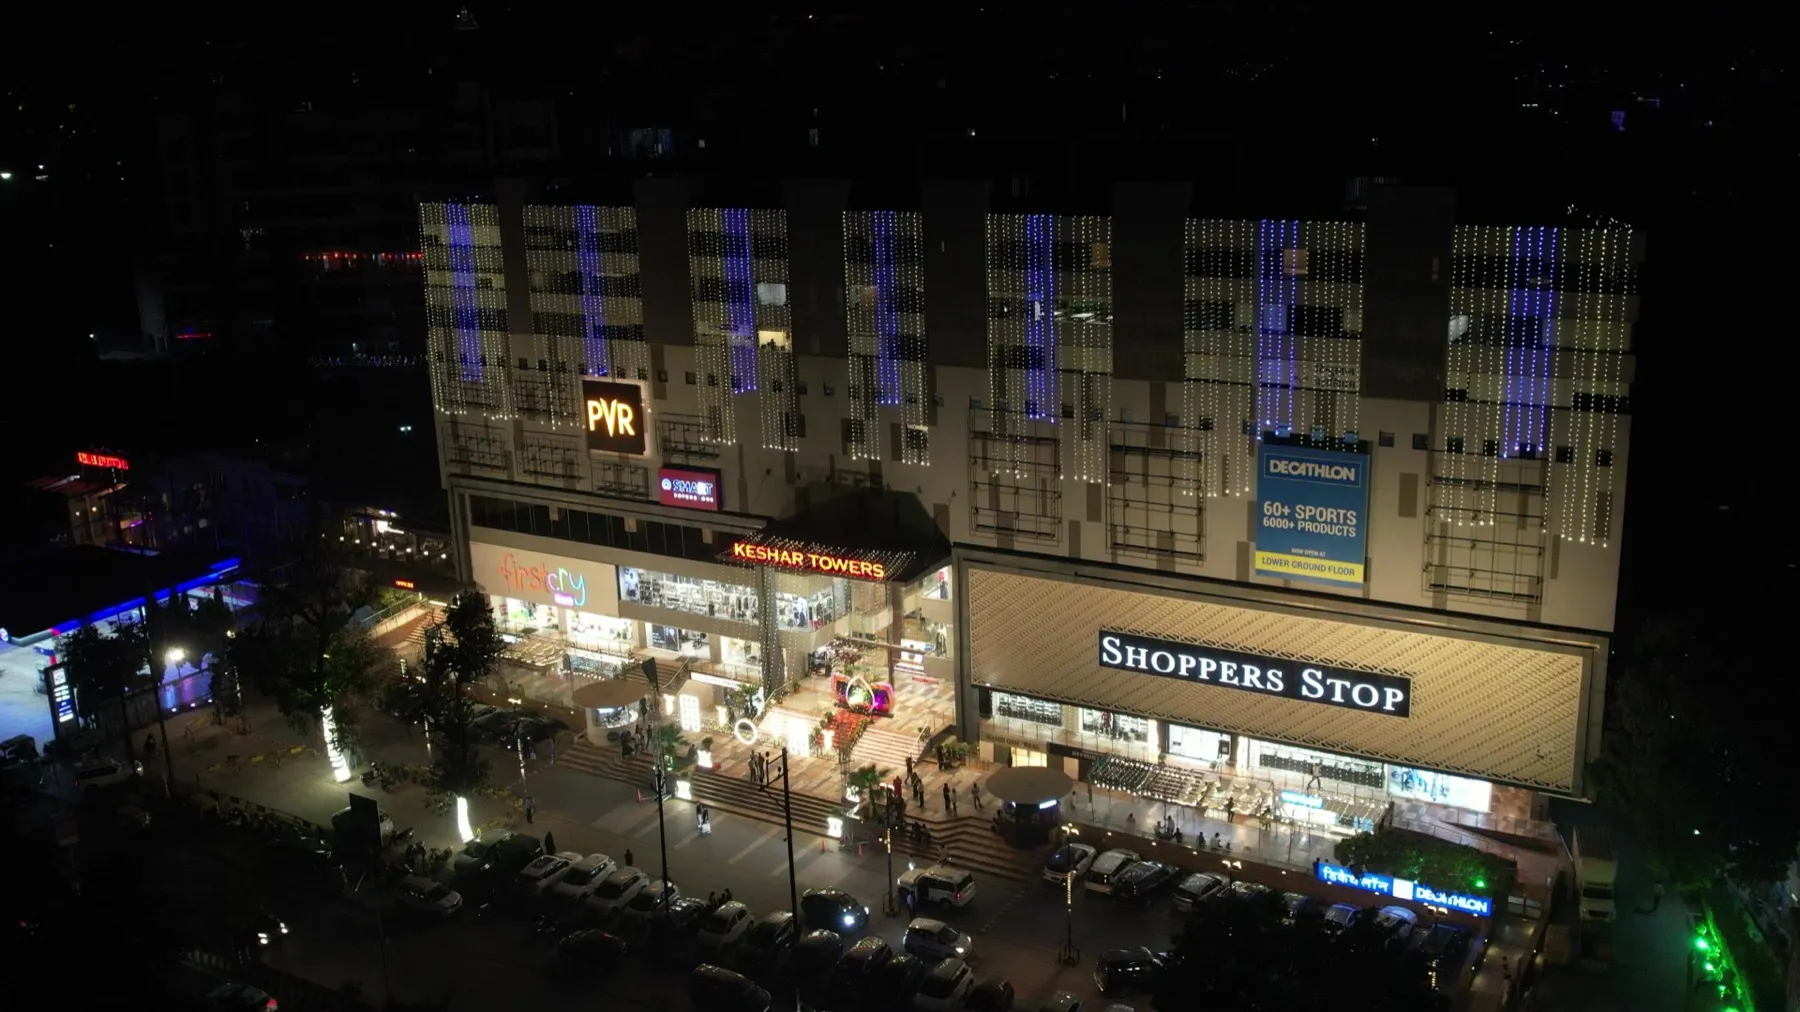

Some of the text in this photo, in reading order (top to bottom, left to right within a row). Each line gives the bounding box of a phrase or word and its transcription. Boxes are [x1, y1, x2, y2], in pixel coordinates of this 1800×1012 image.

[587, 397, 636, 437] PVR
[1269, 459, 1356, 481] DECATHLON
[672, 479, 713, 496] SMAT
[1263, 501, 1357, 526] 60+ SPORTS
[1263, 516, 1356, 538] 6000+ PRODUCTS
[734, 542, 885, 578] KESHAR TOWERS
[1261, 556, 1356, 577] LOWER GROUND FLOOR
[499, 552, 586, 607] firstcry
[1416, 886, 1488, 913] DECATHLON
